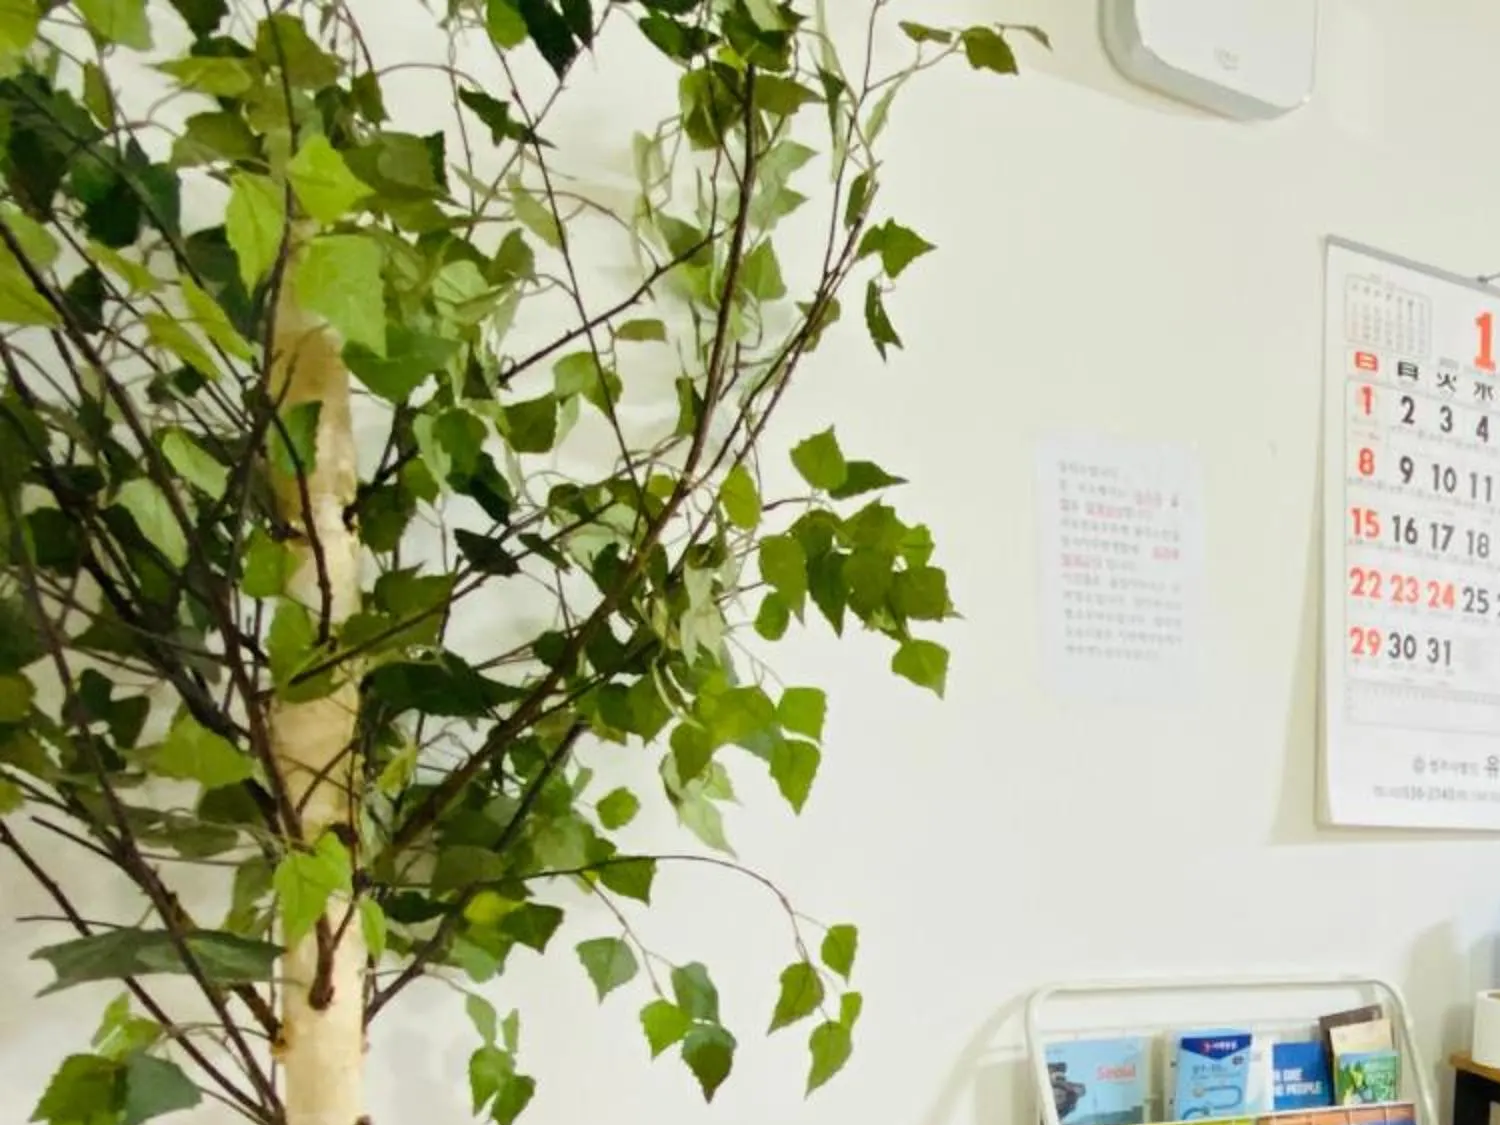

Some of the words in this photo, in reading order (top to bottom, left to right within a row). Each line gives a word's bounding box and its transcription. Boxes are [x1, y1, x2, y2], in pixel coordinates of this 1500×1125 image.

[1473, 311, 1496, 372] 1
[1354, 351, 1379, 373] 日
[1436, 372, 1457, 392] 火
[1473, 381, 1493, 400] 水
[1360, 386, 1373, 415] 1
[1400, 395, 1415, 425] 2
[1440, 405, 1453, 433] 3
[1476, 415, 1489, 442] 4
[1358, 447, 1375, 476] 8
[1399, 455, 1414, 484] 9
[1432, 463, 1457, 493] 10
[1470, 473, 1492, 502] 11
[1351, 507, 1380, 538] 15
[1392, 515, 1418, 545] 16
[1430, 522, 1455, 551] 17
[1466, 530, 1490, 559] 18
[1349, 567, 1382, 599] 22
[1390, 574, 1419, 604] 23
[1427, 580, 1456, 609] 24
[1462, 587, 1490, 614] 25
[1350, 627, 1381, 656] 29
[1388, 632, 1417, 660] 30
[1426, 637, 1452, 666] 31
